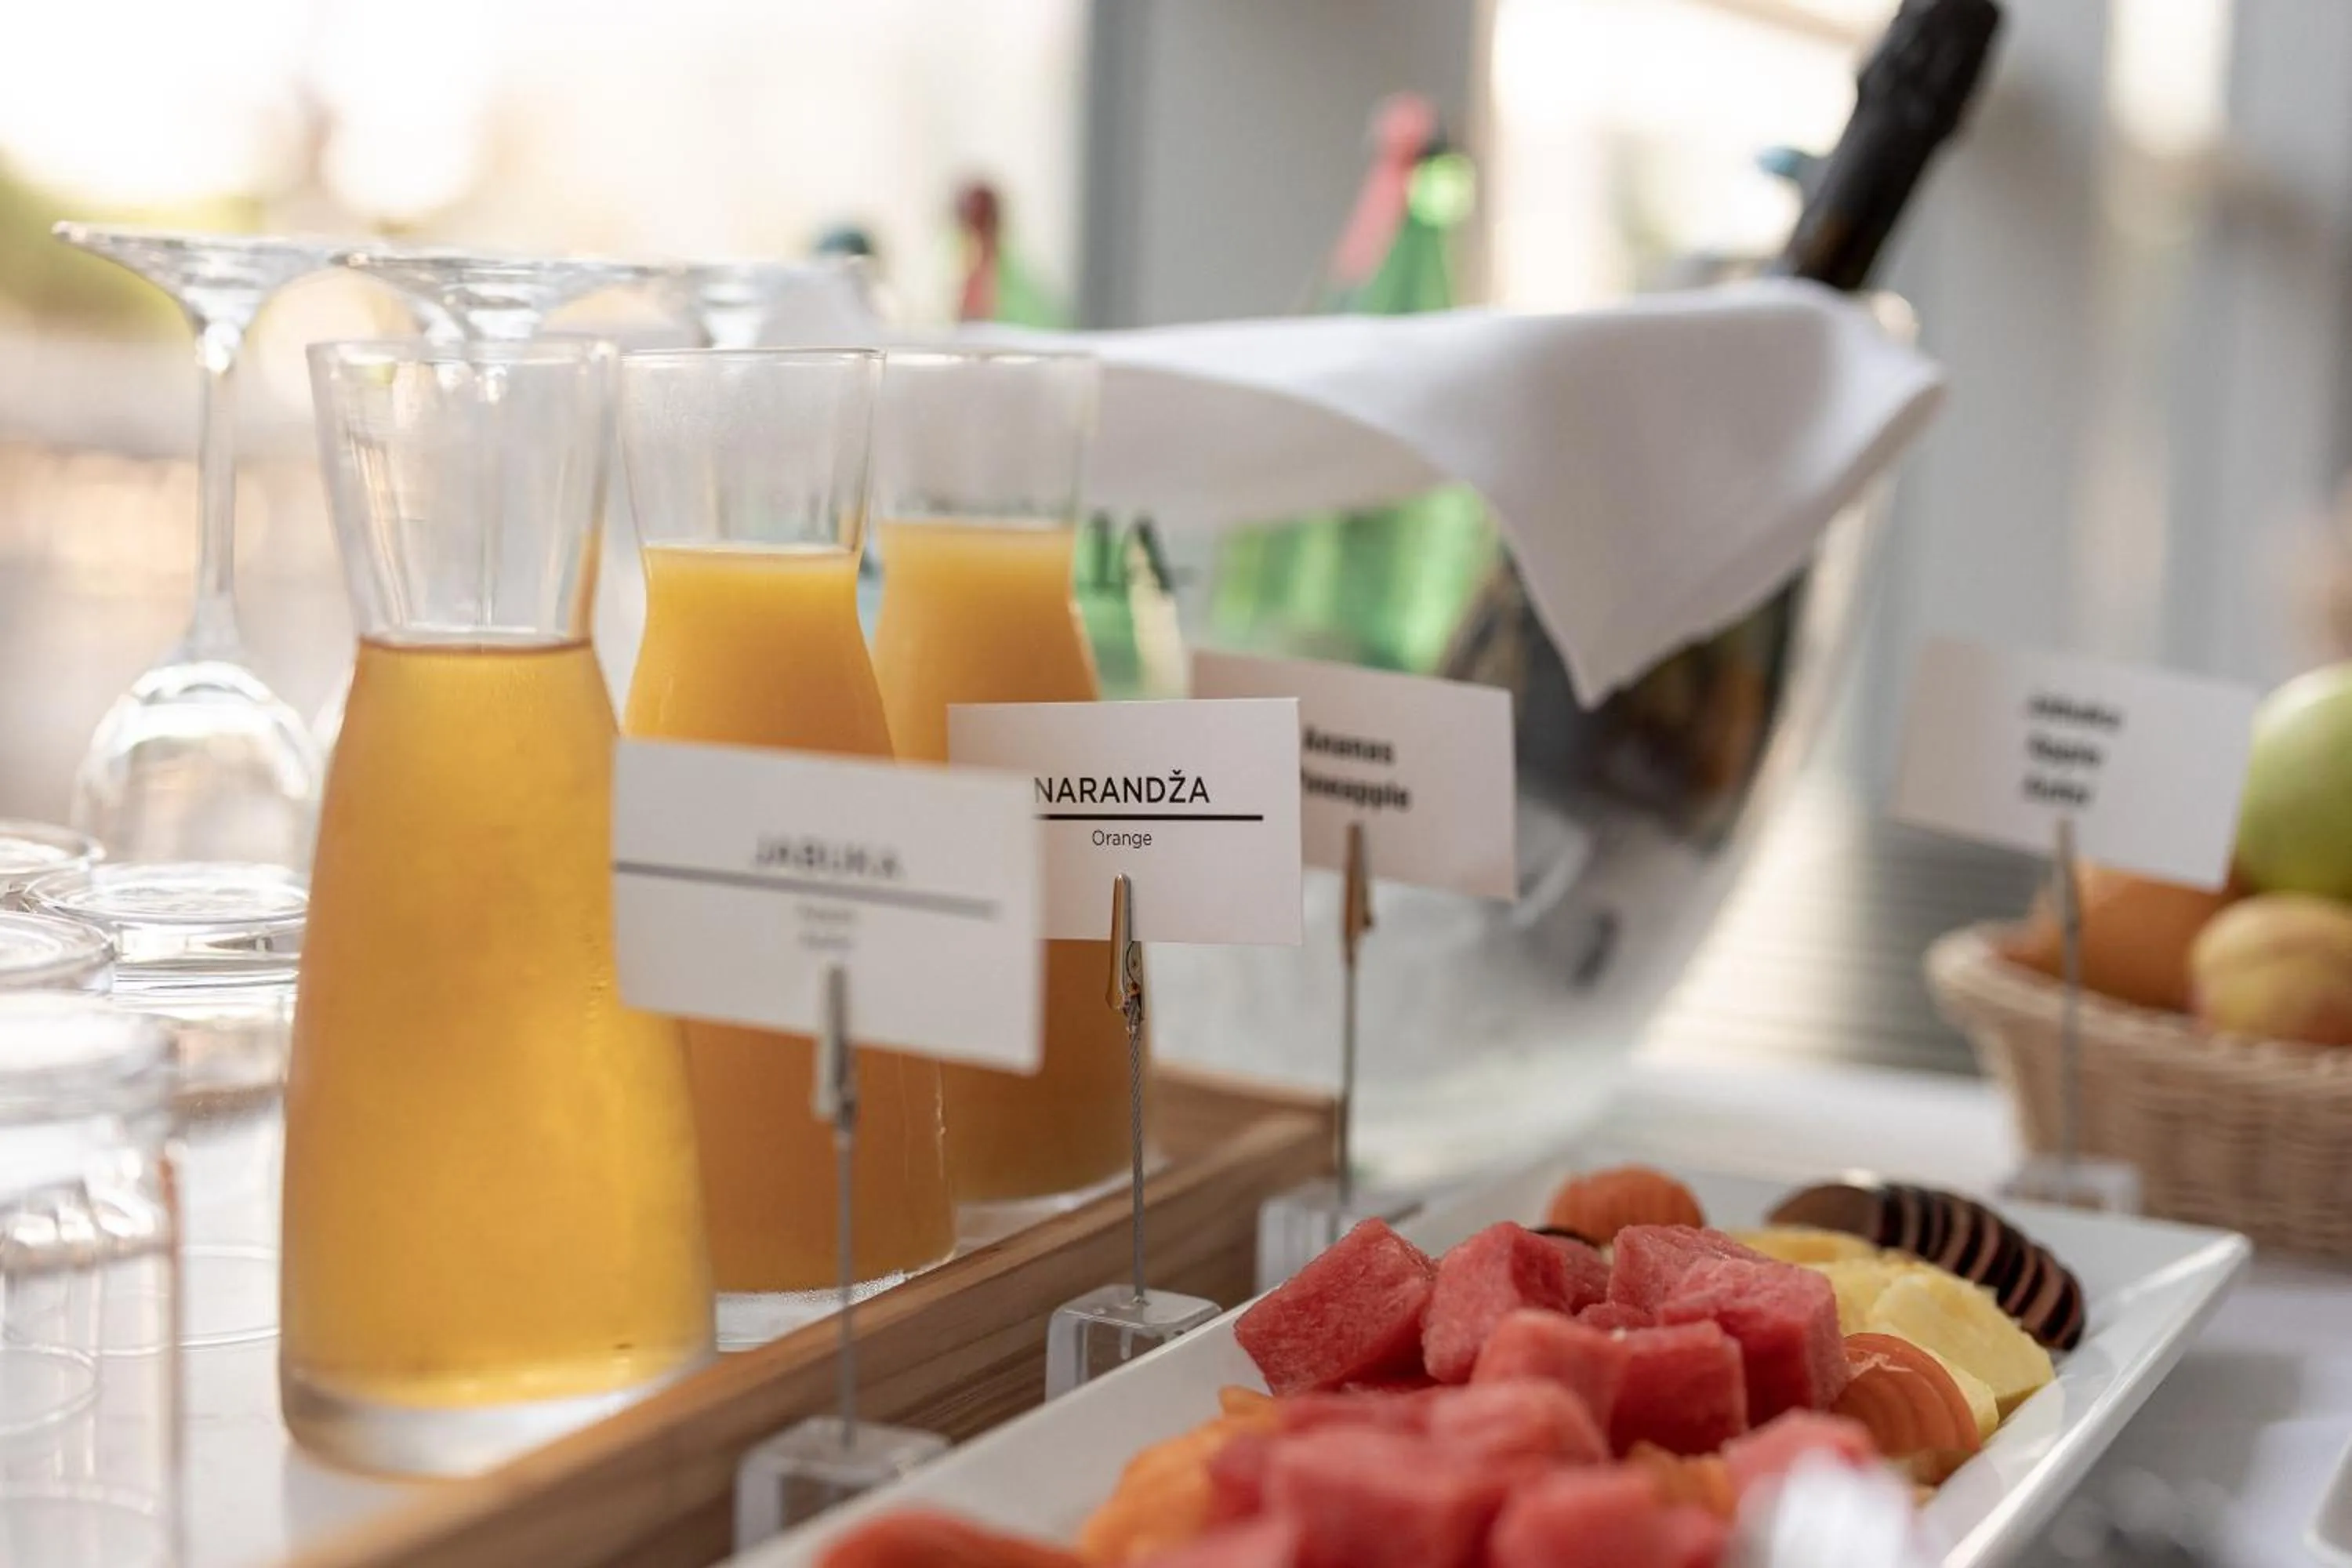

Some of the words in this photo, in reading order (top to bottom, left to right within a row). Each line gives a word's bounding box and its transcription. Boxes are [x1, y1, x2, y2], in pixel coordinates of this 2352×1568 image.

[1033, 769, 1210, 804] NARANDŽA
[1301, 767, 1410, 811] ineapple
[1091, 829, 1152, 848] Orange
